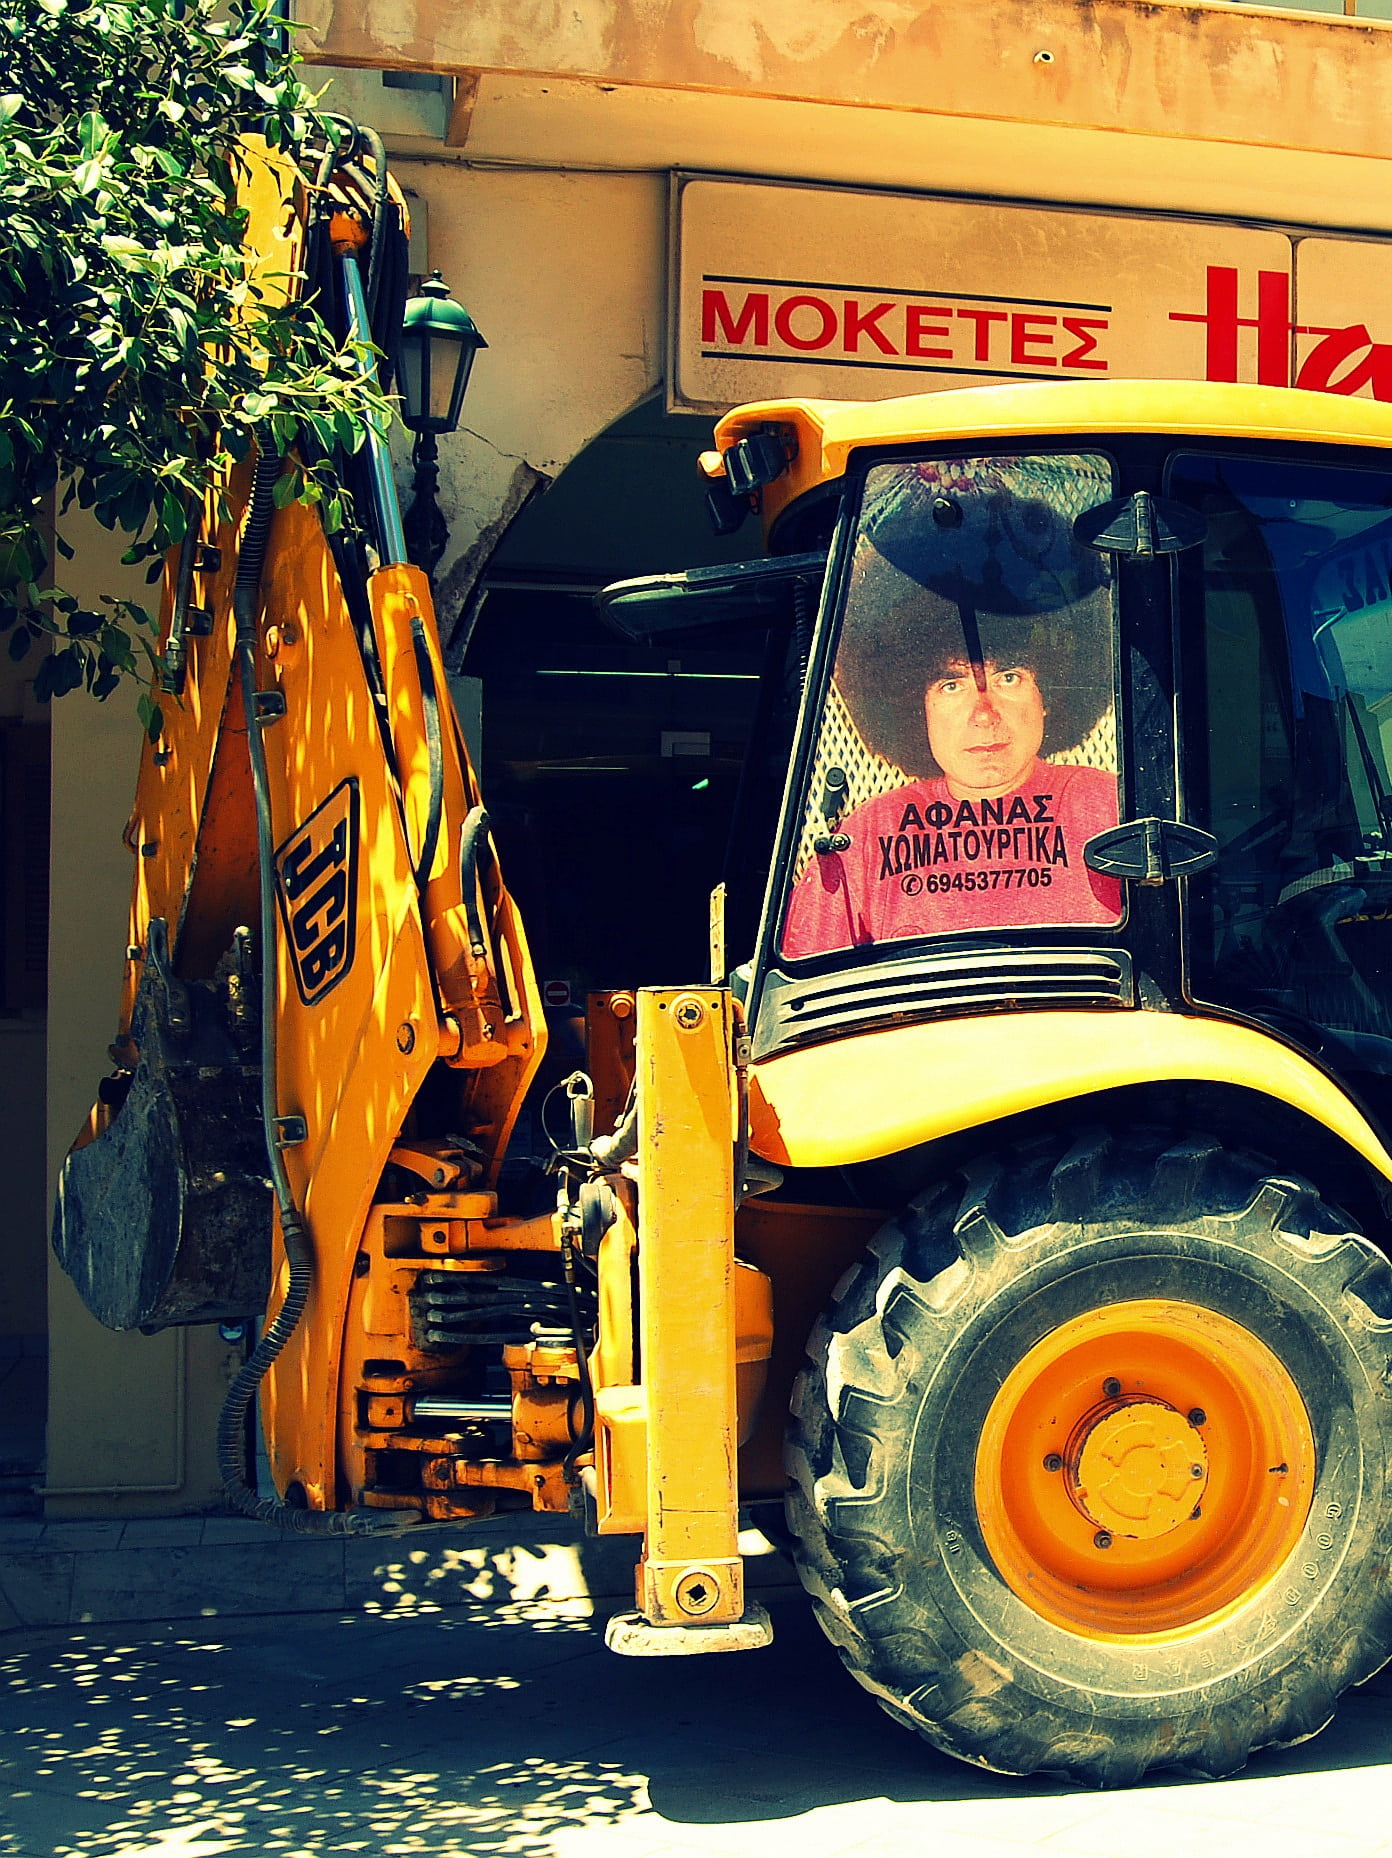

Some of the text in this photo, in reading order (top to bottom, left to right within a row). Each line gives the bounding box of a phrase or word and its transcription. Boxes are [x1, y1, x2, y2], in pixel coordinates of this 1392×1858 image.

[702, 289, 1109, 371] ΜΟΚΕΤΕΣ
[900, 795, 1054, 832] ΑΦΑΝΑΣ
[878, 825, 1069, 881] ΧΩΜΑΤΟΥΡΓΙΚΑ
[926, 867, 1052, 894] 6945377705
[281, 817, 348, 991] JCB
